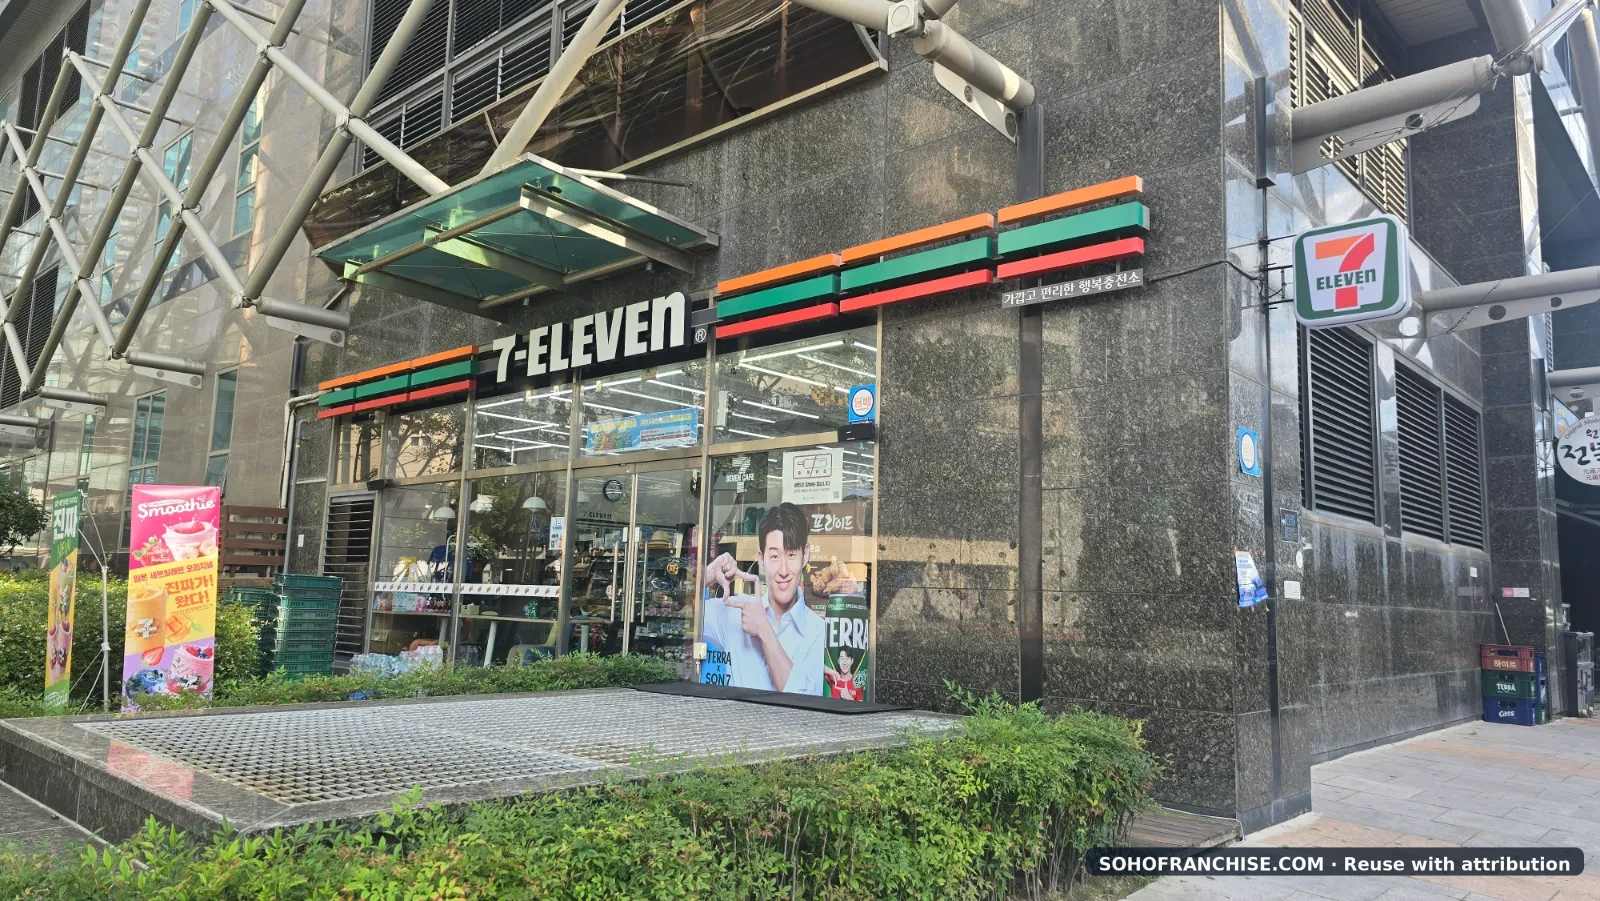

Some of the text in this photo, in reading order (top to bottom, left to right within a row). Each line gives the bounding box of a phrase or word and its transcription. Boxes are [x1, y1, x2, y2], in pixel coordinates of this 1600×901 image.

[1004, 271, 1141, 305] 가깝고 편리한 행복충전소
[854, 395, 872, 408] 담배
[1586, 428, 1600, 439] 원
[137, 496, 216, 519] Smoothie
[53, 505, 78, 541] 진짜
[810, 513, 854, 532] 프라이드
[133, 561, 214, 583] 일본 세븐일레븐 오리지널
[165, 574, 214, 594] 진짜가!
[175, 591, 210, 608] 왔다!
[707, 650, 732, 666] TERRA
[1493, 659, 1517, 669] 하이트
[1496, 682, 1517, 692] TERRA
